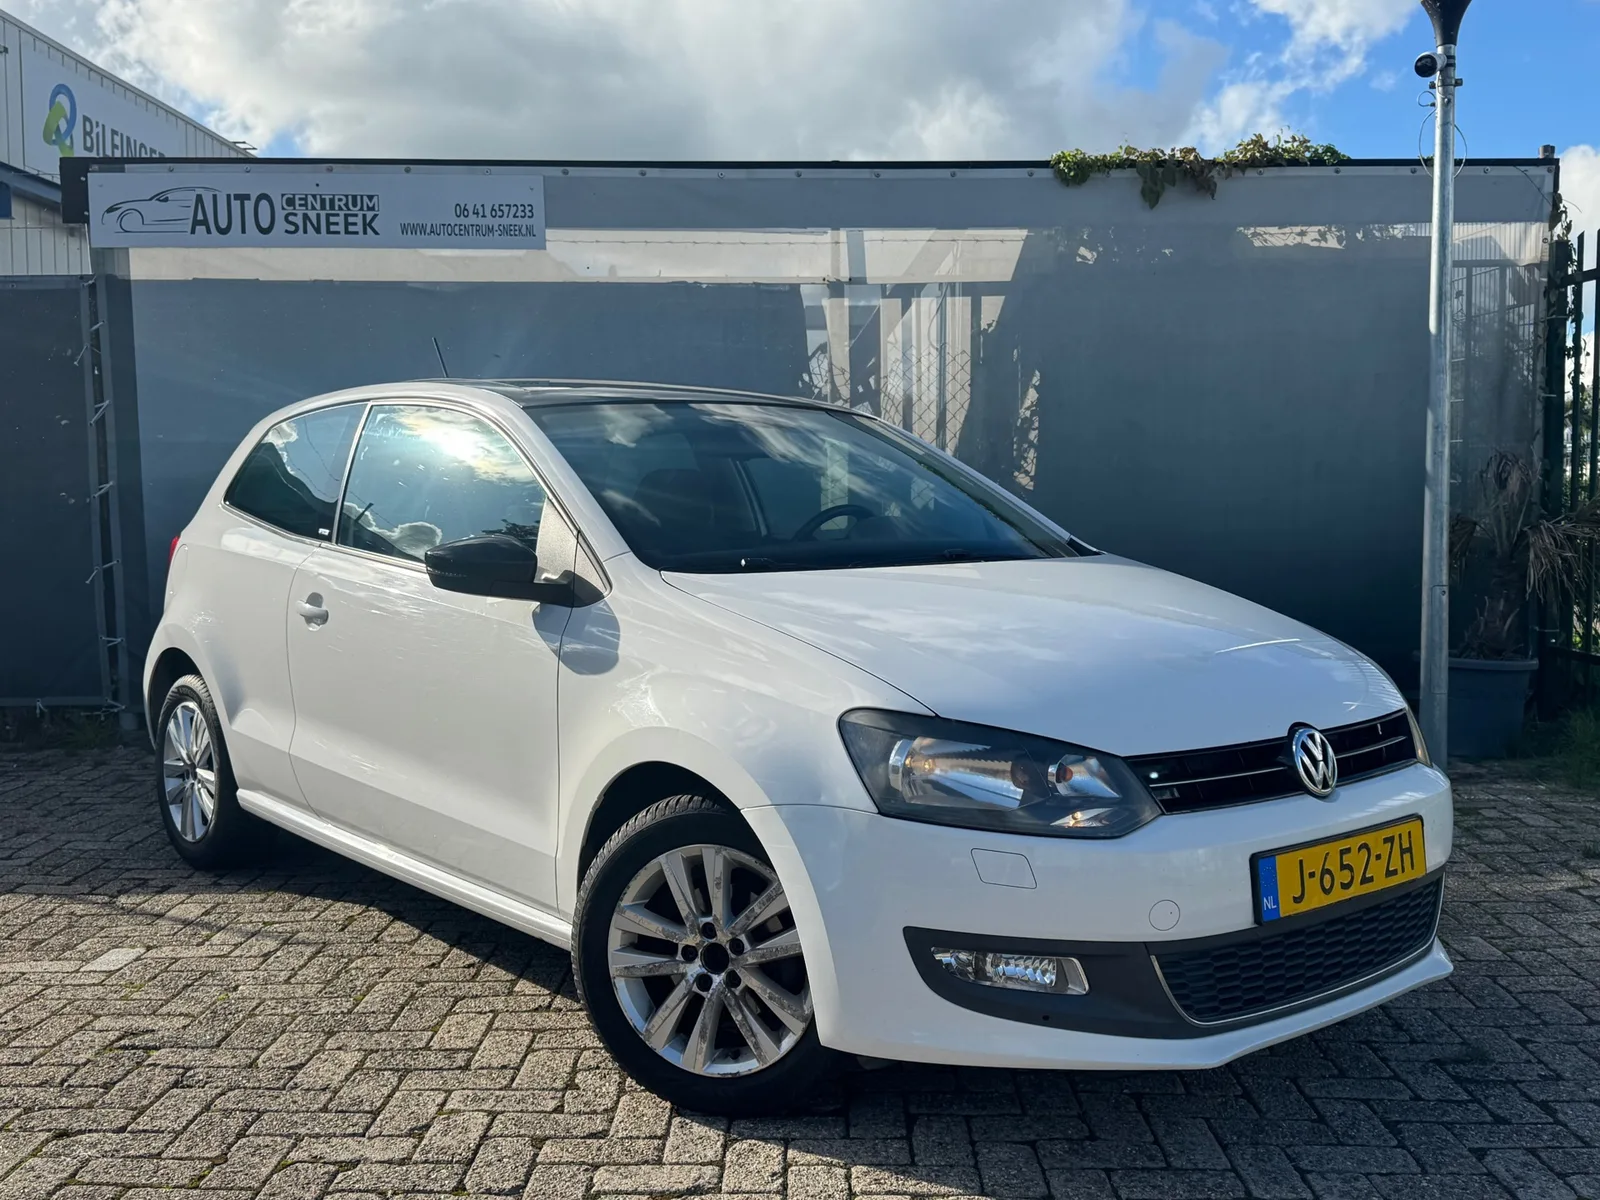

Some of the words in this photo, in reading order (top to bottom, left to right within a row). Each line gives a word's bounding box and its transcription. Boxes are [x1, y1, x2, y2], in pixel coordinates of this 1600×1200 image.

[281, 194, 379, 211] CENTRUM
[454, 203, 470, 218] 06
[472, 203, 487, 218] 41
[490, 203, 534, 219] 657233
[190, 192, 276, 236] AUTO
[284, 212, 380, 236] SNEEK
[400, 223, 537, 237] WWW.AUTOCENTRUM-SNEEK.NL
[1292, 830, 1415, 904] J-652-ZH
[1263, 896, 1277, 910] NL
